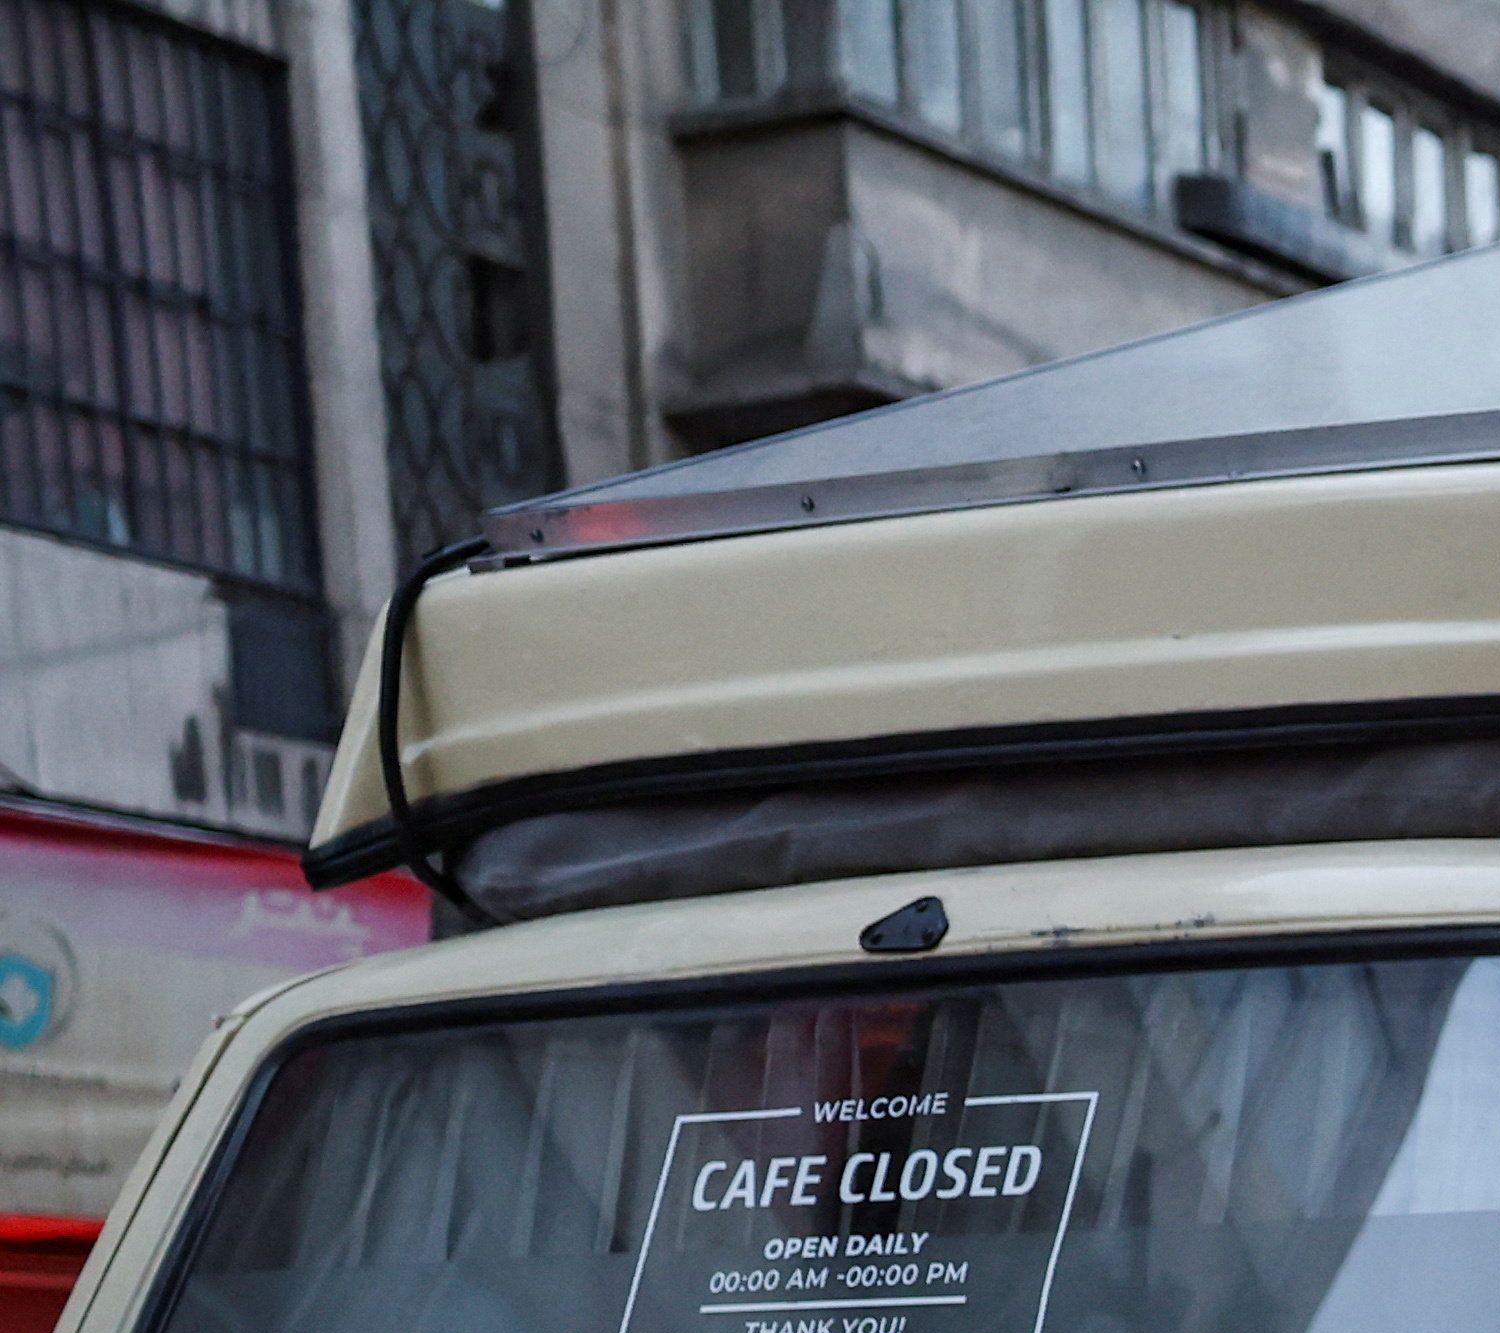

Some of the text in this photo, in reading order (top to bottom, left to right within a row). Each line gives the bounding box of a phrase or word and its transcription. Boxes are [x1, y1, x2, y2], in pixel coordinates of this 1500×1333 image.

[814, 1091, 949, 1124] WELCOME
[692, 1145, 1042, 1211] CAFE CLOSED
[764, 1232, 929, 1260] OPEN DAILY
[709, 1268, 780, 1294] 00:00
[785, 1266, 830, 1290] AM
[926, 1261, 969, 1285] PM
